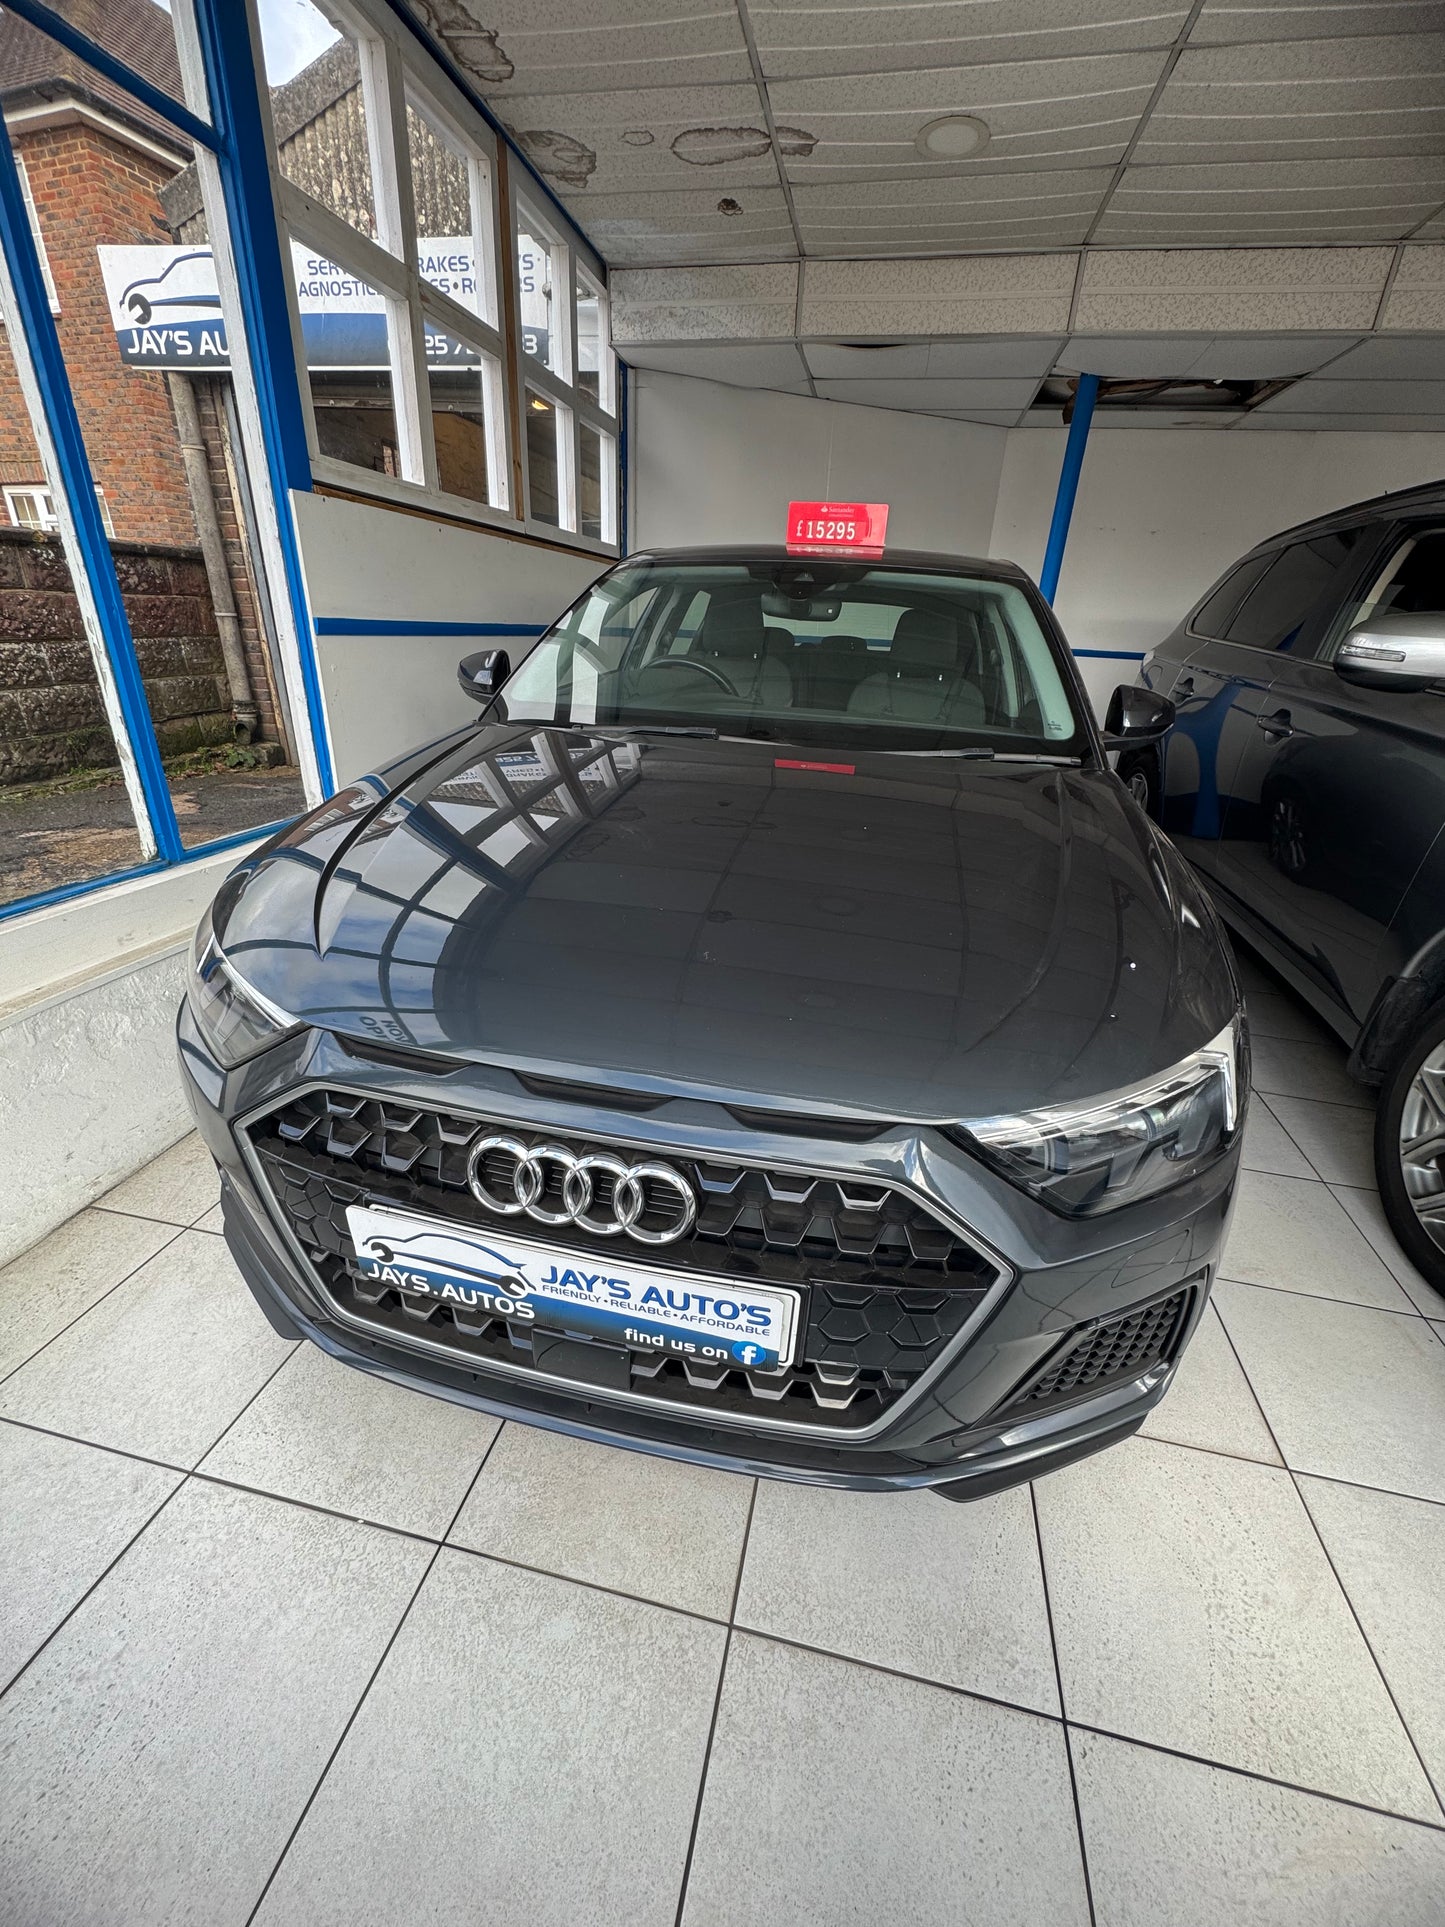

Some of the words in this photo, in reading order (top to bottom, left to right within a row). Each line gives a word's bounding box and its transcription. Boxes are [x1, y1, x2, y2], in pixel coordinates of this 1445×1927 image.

[307, 260, 347, 276] SER
[418, 255, 470, 273] RAKES
[299, 280, 383, 297] AGNOSTIC
[127, 329, 193, 356] JAY'S
[200, 330, 230, 356] AU
[540, 1265, 632, 1300] JAY'S
[641, 1286, 773, 1328] AUTO'S
[542, 1284, 602, 1304] FRIENDLY
[610, 1299, 672, 1319] RELIABLE
[680, 1312, 771, 1337] AFFORDABLE
[624, 1327, 665, 1348] find
[670, 1339, 697, 1353] us
[701, 1346, 729, 1360] on
